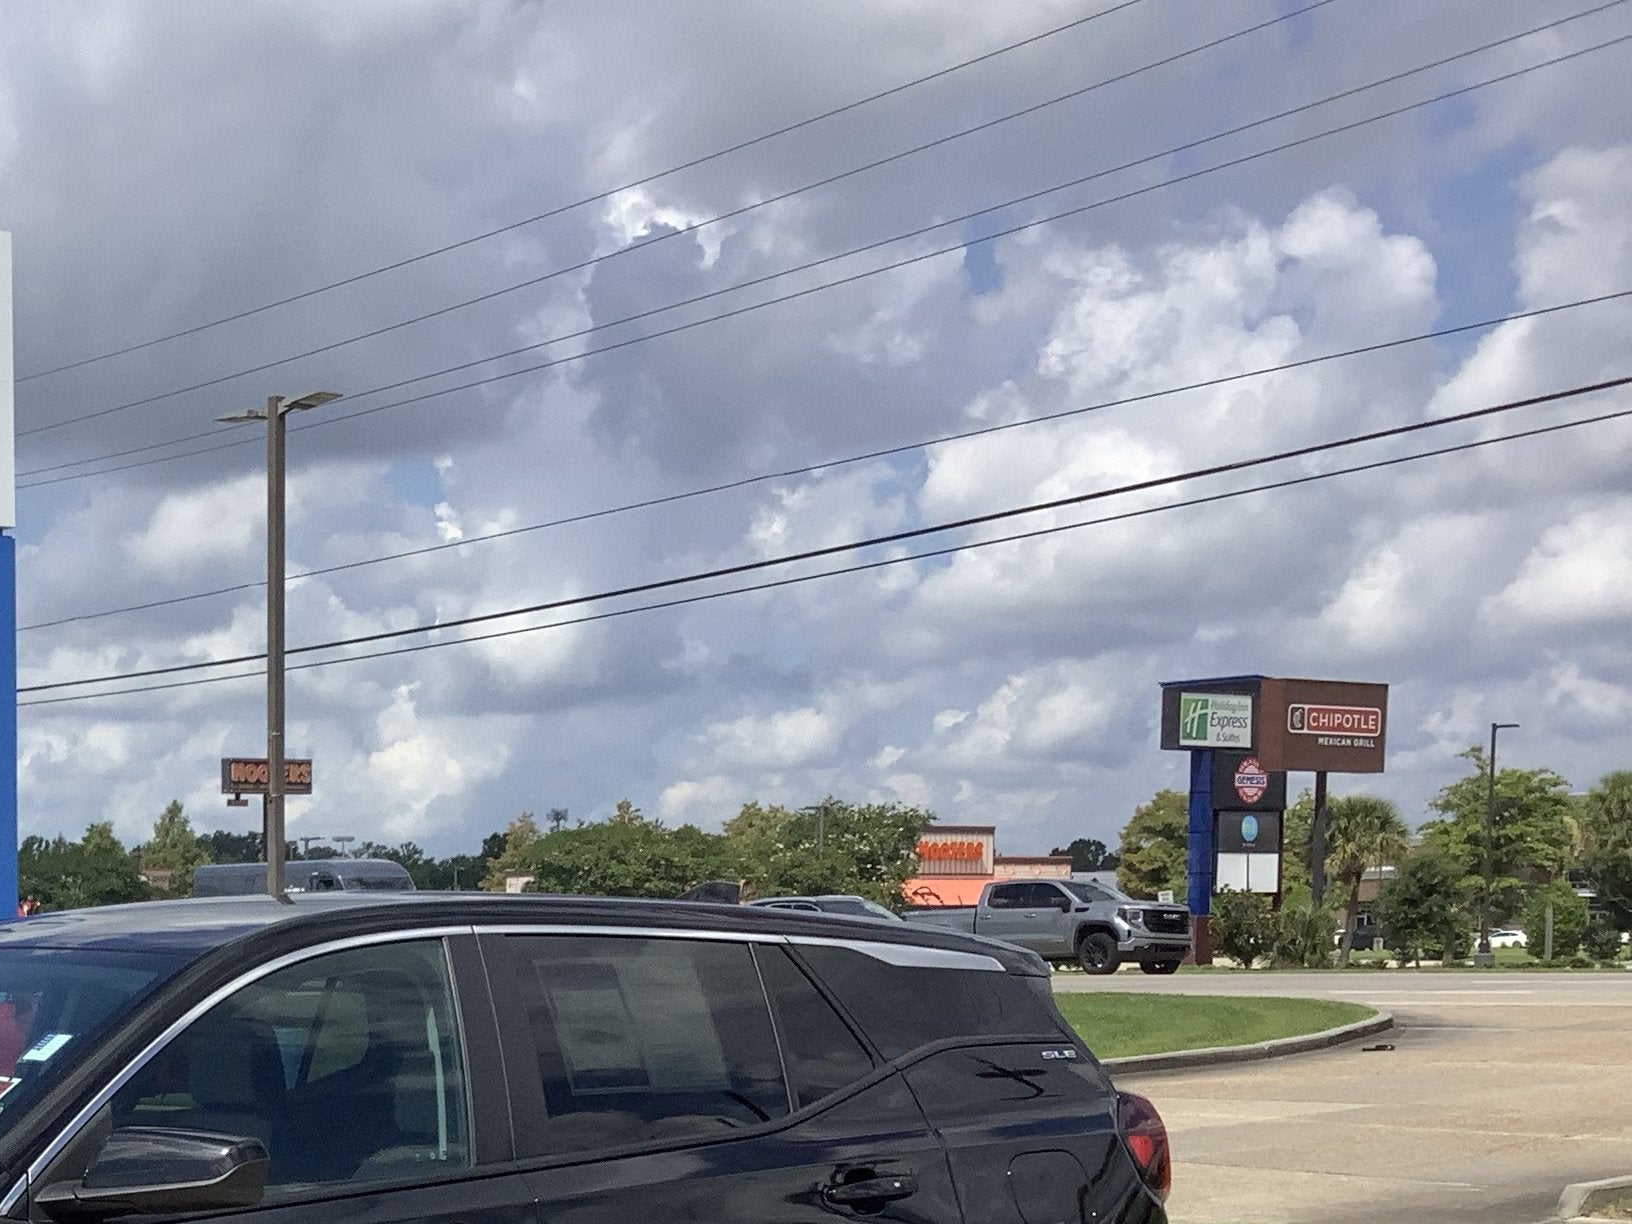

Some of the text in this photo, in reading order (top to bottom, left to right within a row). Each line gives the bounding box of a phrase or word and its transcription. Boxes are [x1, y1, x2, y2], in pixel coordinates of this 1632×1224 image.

[1210, 712, 1248, 730] Express
[1309, 712, 1377, 730] CHIPOTLE
[1317, 737, 1375, 747] MEXICAN GRILL
